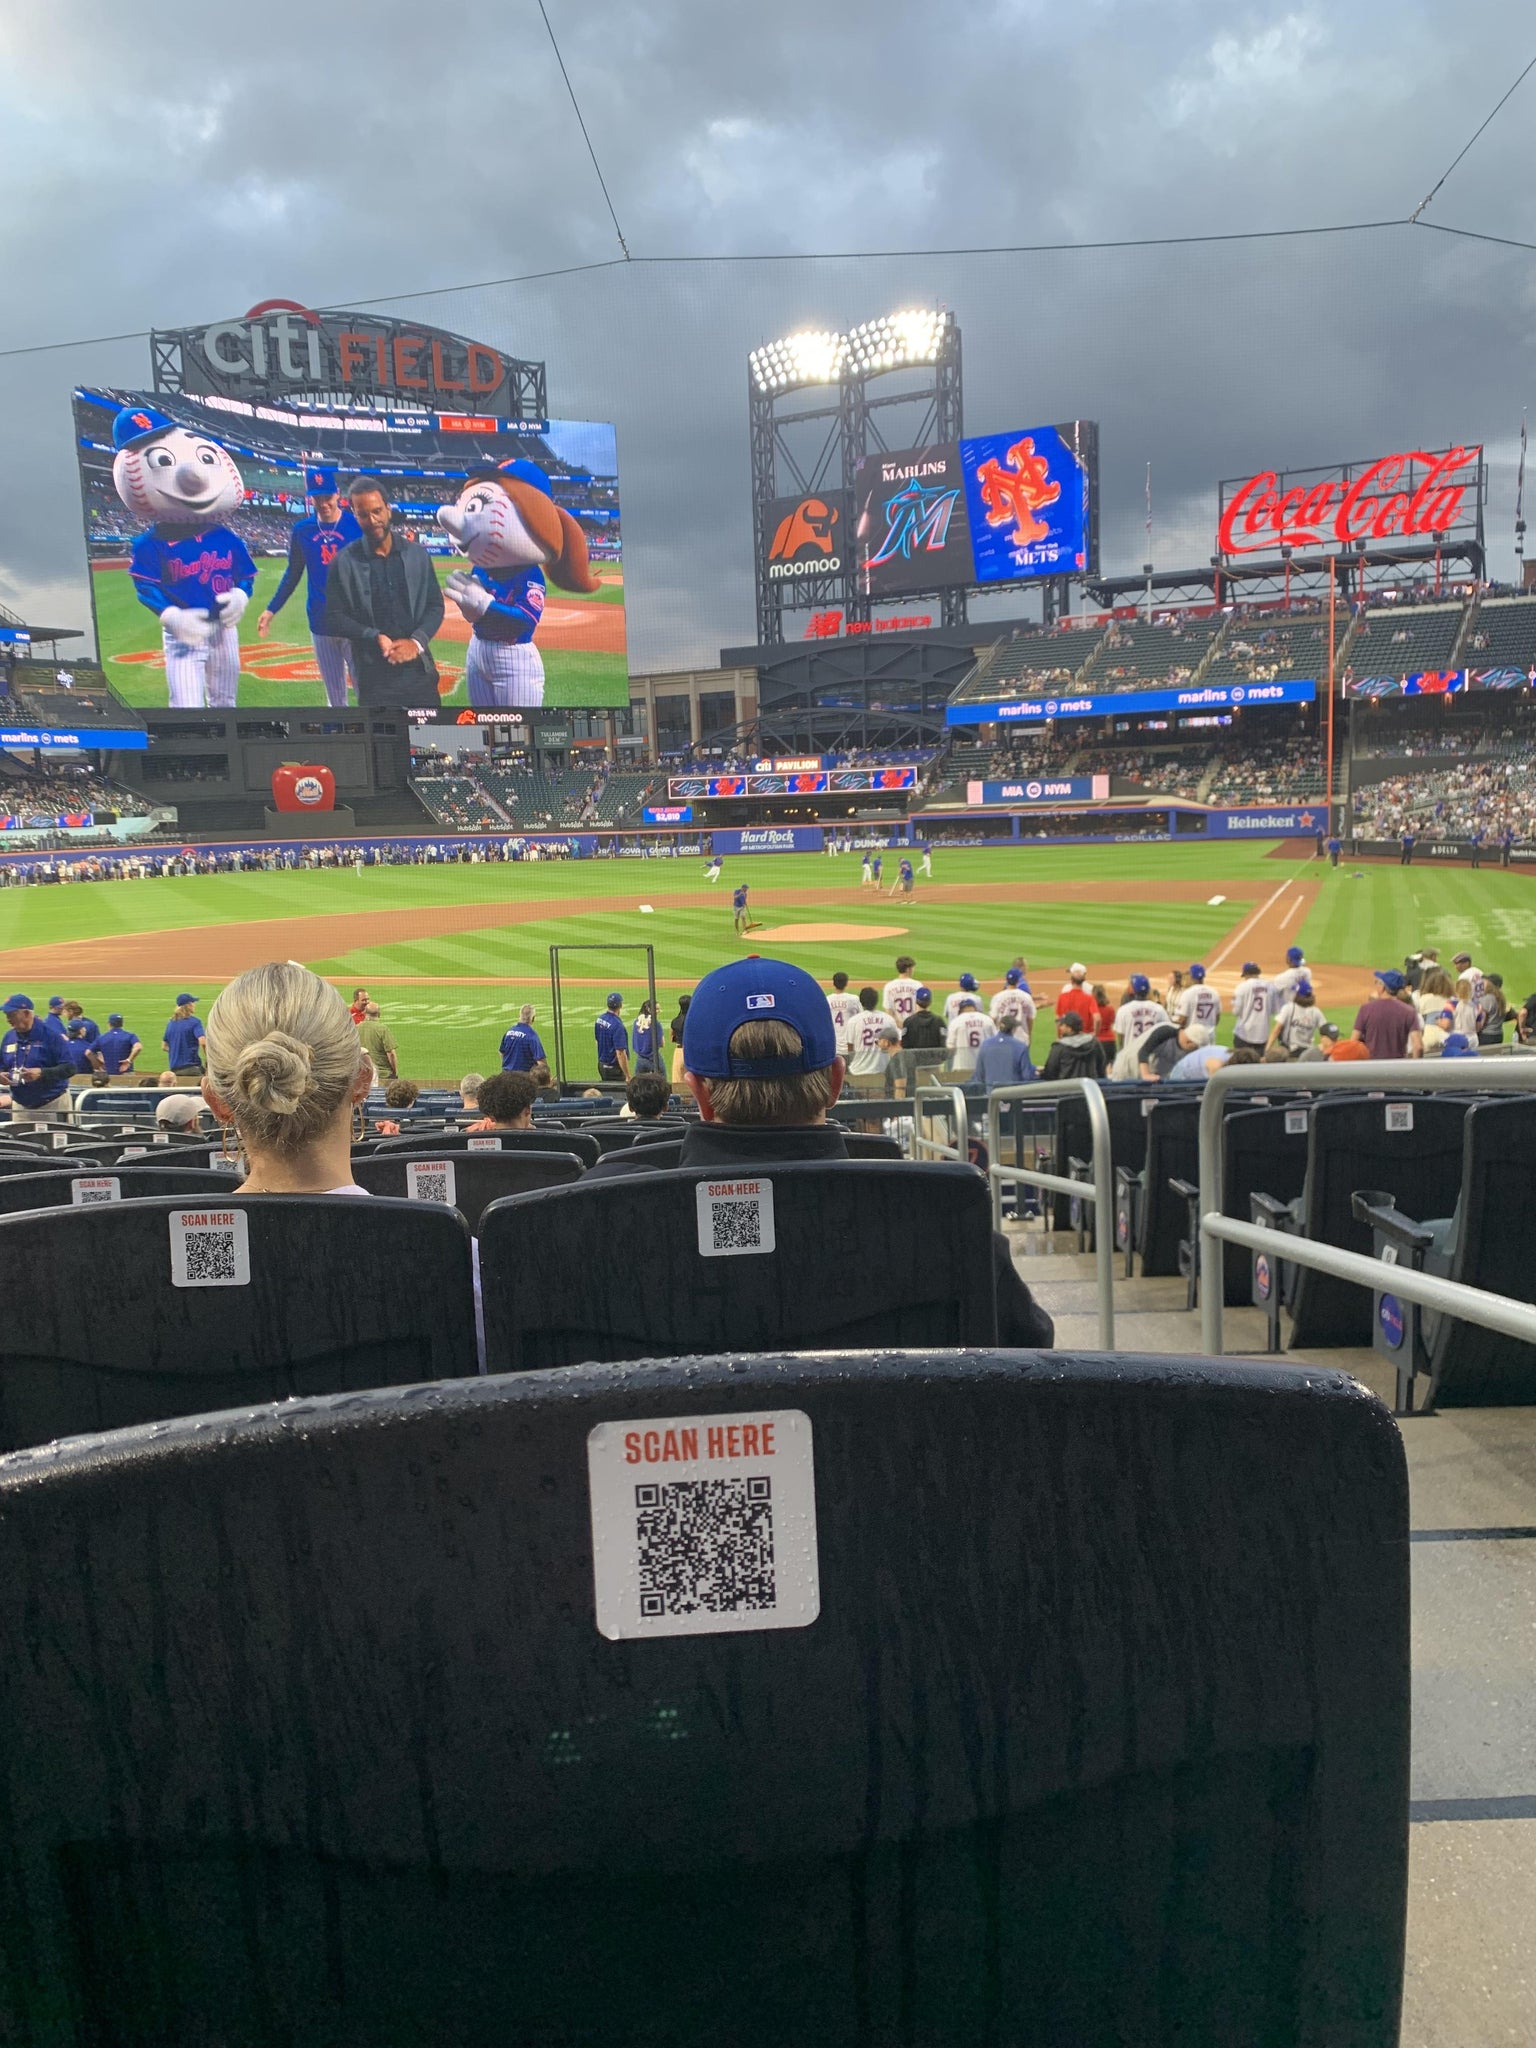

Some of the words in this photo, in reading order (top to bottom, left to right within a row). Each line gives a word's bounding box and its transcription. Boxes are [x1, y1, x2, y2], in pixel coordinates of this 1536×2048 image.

[204, 314, 321, 380] citi
[340, 332, 503, 393] FIELD
[882, 460, 947, 482] MARLINS
[1015, 548, 1059, 567] METS
[769, 557, 841, 578] moomoo
[845, 620, 873, 635] new
[875, 614, 932, 632] balance
[1178, 688, 1227, 704] marlins
[1248, 686, 1284, 699] mets
[999, 703, 1042, 717] marlins
[1060, 700, 1092, 712] mets
[477, 713, 522, 722] moomoo
[1, 732, 38, 743] marlins
[53, 733, 79, 744] mets
[776, 760, 819, 770] PAVILION
[1002, 786, 1024, 797] MIA
[1044, 783, 1071, 795] NYM
[1227, 814, 1295, 830] Heineken
[741, 831, 768, 843] Hard
[769, 829, 794, 843] Rock
[934, 839, 982, 847] CADILLAC
[1115, 833, 1172, 842] CADILLAC
[679, 845, 700, 853] GOYA
[1438, 845, 1458, 855] DELTA
[894, 997, 913, 1014] 30
[1197, 1003, 1214, 1019] 57
[1253, 996, 1264, 1012] 3
[834, 1011, 844, 1027] 4
[969, 1031, 980, 1047] 6
[414, 1163, 431, 1172] SCAN
[431, 1163, 447, 1171] HERE
[79, 1179, 95, 1188] SCAN
[96, 1179, 113, 1188] HERE
[708, 1184, 735, 1197] SCAN
[736, 1182, 760, 1195] HERE
[181, 1214, 208, 1227] SCAN
[210, 1213, 236, 1226] HERE
[624, 1428, 699, 1465] SCAN
[707, 1423, 776, 1459] HERE
